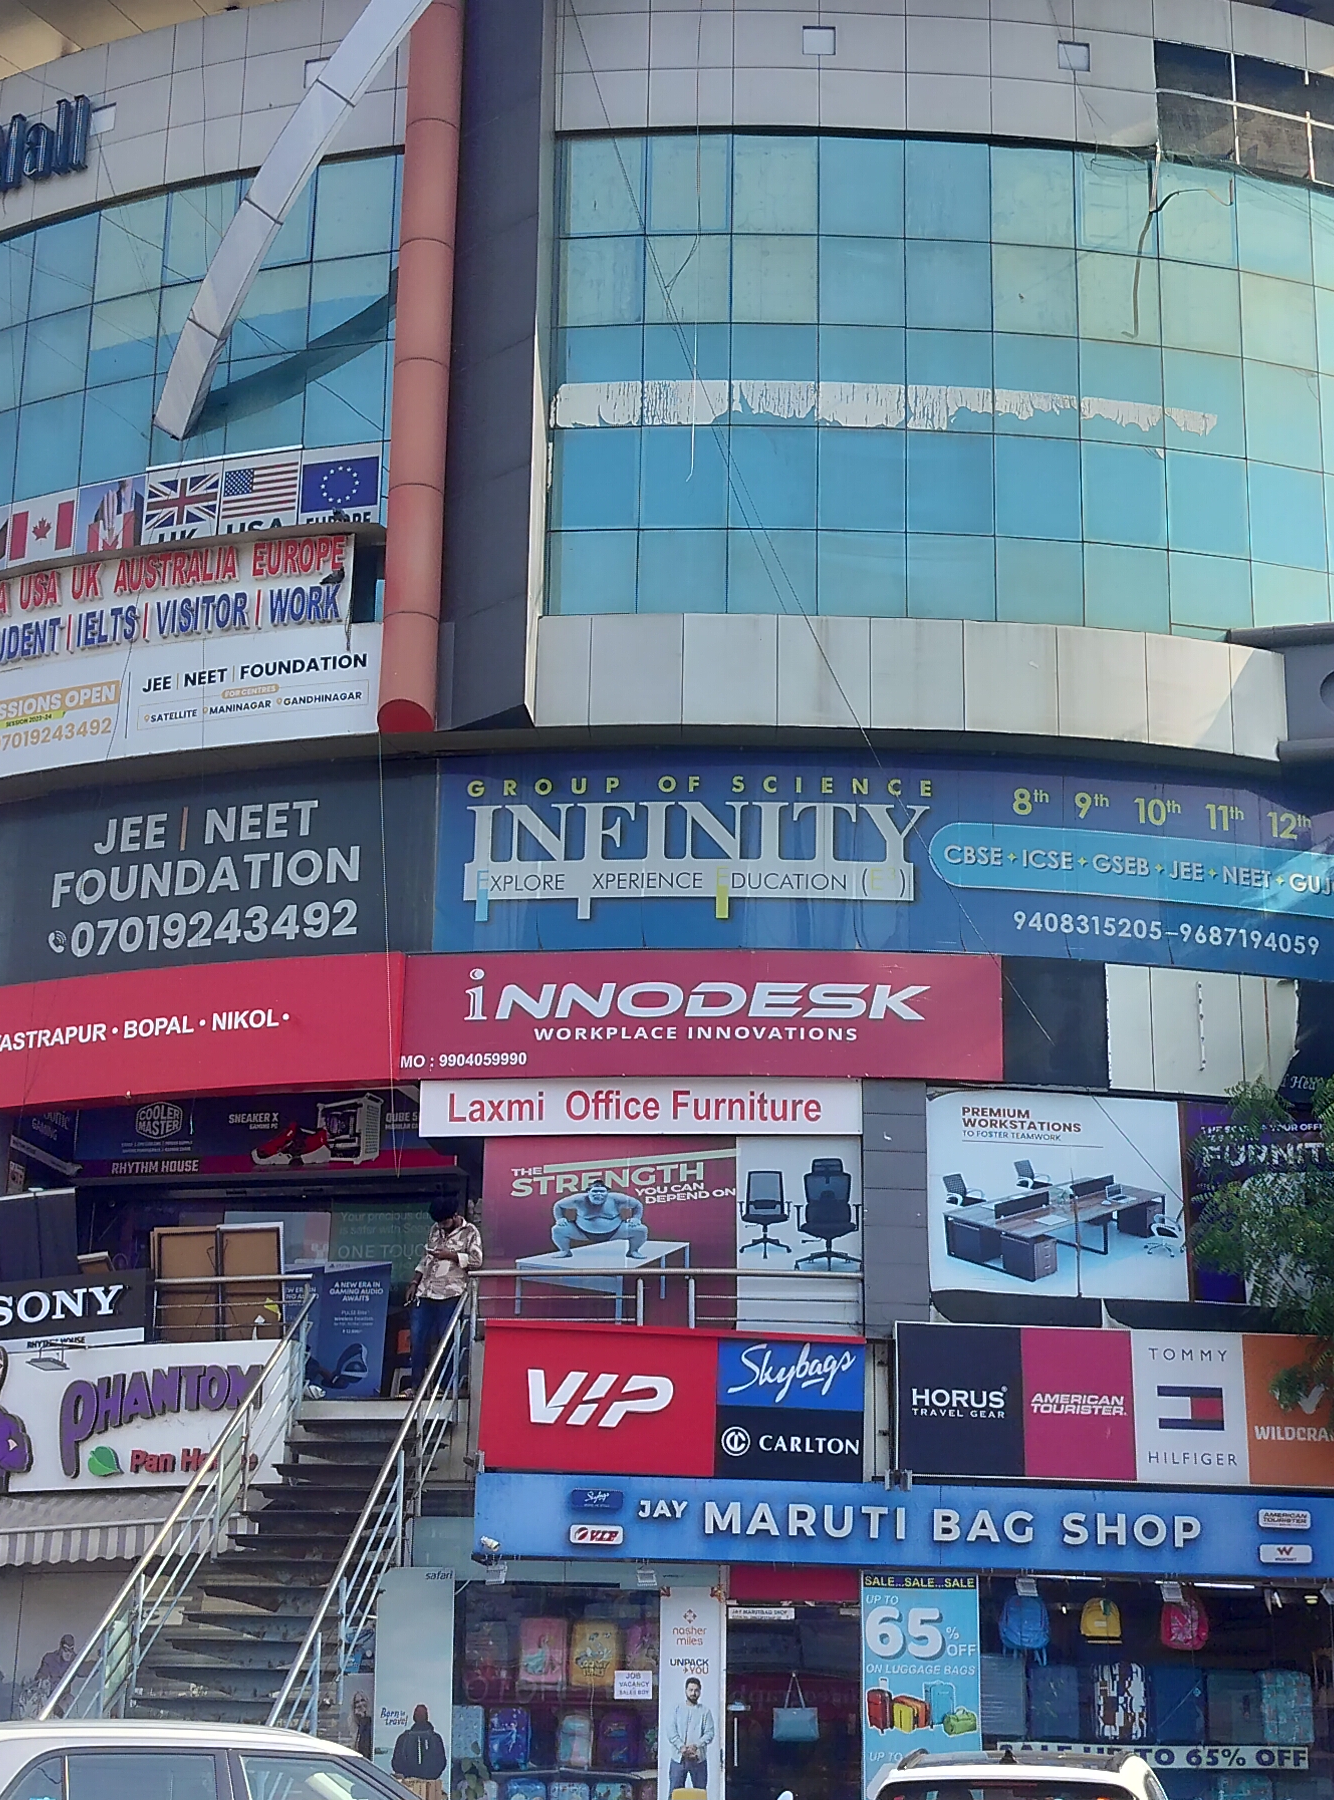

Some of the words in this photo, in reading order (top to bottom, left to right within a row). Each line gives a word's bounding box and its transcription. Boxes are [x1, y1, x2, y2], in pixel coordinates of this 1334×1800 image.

[20, 570, 60, 610] USA
[72, 562, 102, 600] UK
[114, 545, 238, 594] AUSTRALIA
[252, 536, 346, 577] EUROPE
[77, 604, 138, 648] IELTS
[157, 591, 248, 636] VISITOR
[270, 583, 342, 626] WORK
[142, 675, 172, 693] JEE
[183, 667, 228, 688] NEET
[239, 653, 369, 680] FOUNDATION
[64, 683, 116, 708] OPEN
[150, 708, 198, 723] SATELLITE
[209, 699, 272, 716] MANINAGAR
[283, 691, 363, 707] GANDHINAGAR
[466, 776, 621, 798] GROUP
[657, 775, 702, 794] OF
[731, 774, 933, 798] SCIENCE
[1012, 787, 1050, 816] 8th
[1074, 791, 1110, 820] 9th
[1134, 796, 1182, 826] 10th
[1205, 802, 1245, 832] 11th
[94, 812, 169, 856] JEE
[204, 800, 319, 845] NEET
[466, 801, 931, 866] INFINITY
[943, 844, 1003, 867] CBSE
[1022, 848, 1073, 871] ICSE
[1092, 853, 1151, 877] GSEB
[1169, 860, 1204, 882] JEE
[1222, 866, 1271, 889] NEET
[50, 845, 362, 909] FOUNDATION
[71, 899, 359, 959] 07019243492
[123, 1015, 195, 1040] BOPAL
[211, 1008, 280, 1032] NIKOL
[533, 1025, 679, 1043] WORKPLACE
[686, 1025, 859, 1044] INNOVATIONS
[438, 1052, 528, 1070] 9904059990
[139, 1103, 181, 1120] COOLER
[447, 1091, 546, 1124] Laxmi
[565, 1089, 661, 1123] Office
[671, 1089, 823, 1124] Furniture
[961, 1106, 1031, 1119] PREMIUM
[138, 1119, 181, 1136] MASTER
[228, 1113, 271, 1124] SNEAKER
[962, 1118, 1082, 1133] WORKSTATIONS
[976, 1129, 1009, 1139] FOSTER
[1011, 1131, 1062, 1142] TEAMWORK
[111, 1160, 159, 1175] RHYTHM
[161, 1159, 200, 1174] HOUSE
[510, 1166, 544, 1178] THE
[634, 1186, 667, 1198] YOU
[669, 1182, 705, 1194] CAN
[645, 1190, 710, 1205] DEPEND
[711, 1186, 736, 1199] ON
[337, 1244, 376, 1259] ONE
[1148, 1347, 1229, 1363] TOMMY
[727, 1342, 857, 1404] Skybags
[527, 1368, 675, 1429] VIP
[911, 1387, 1006, 1409] HORUS
[1031, 1393, 1125, 1406] AMERICAN
[60, 1364, 265, 1479] PHANTOM
[912, 1408, 965, 1418] TRAVEL
[970, 1410, 1006, 1419] GEAR
[759, 1434, 860, 1456] CARLTON
[130, 1449, 176, 1473] Pan
[1148, 1450, 1238, 1467] HILFIGER
[638, 1499, 688, 1520] JAY
[703, 1500, 906, 1541] MARUTI
[932, 1508, 1035, 1545] BAG
[1062, 1511, 1201, 1548] SHOP
[425, 1570, 454, 1581] safari
[866, 1594, 882, 1604] UP
[884, 1595, 899, 1605] TO
[672, 1626, 707, 1636] nasher
[865, 1605, 945, 1659] 65
[676, 1636, 704, 1646] miles
[946, 1644, 977, 1657] OFF
[670, 1658, 710, 1668] UNPACK
[867, 1663, 883, 1675] ON
[885, 1664, 942, 1675] LUGGAGE
[944, 1665, 976, 1676] BAGS
[869, 1751, 886, 1762] UP
[1185, 1748, 1247, 1767] 65%
[1255, 1749, 1308, 1767] OFF
